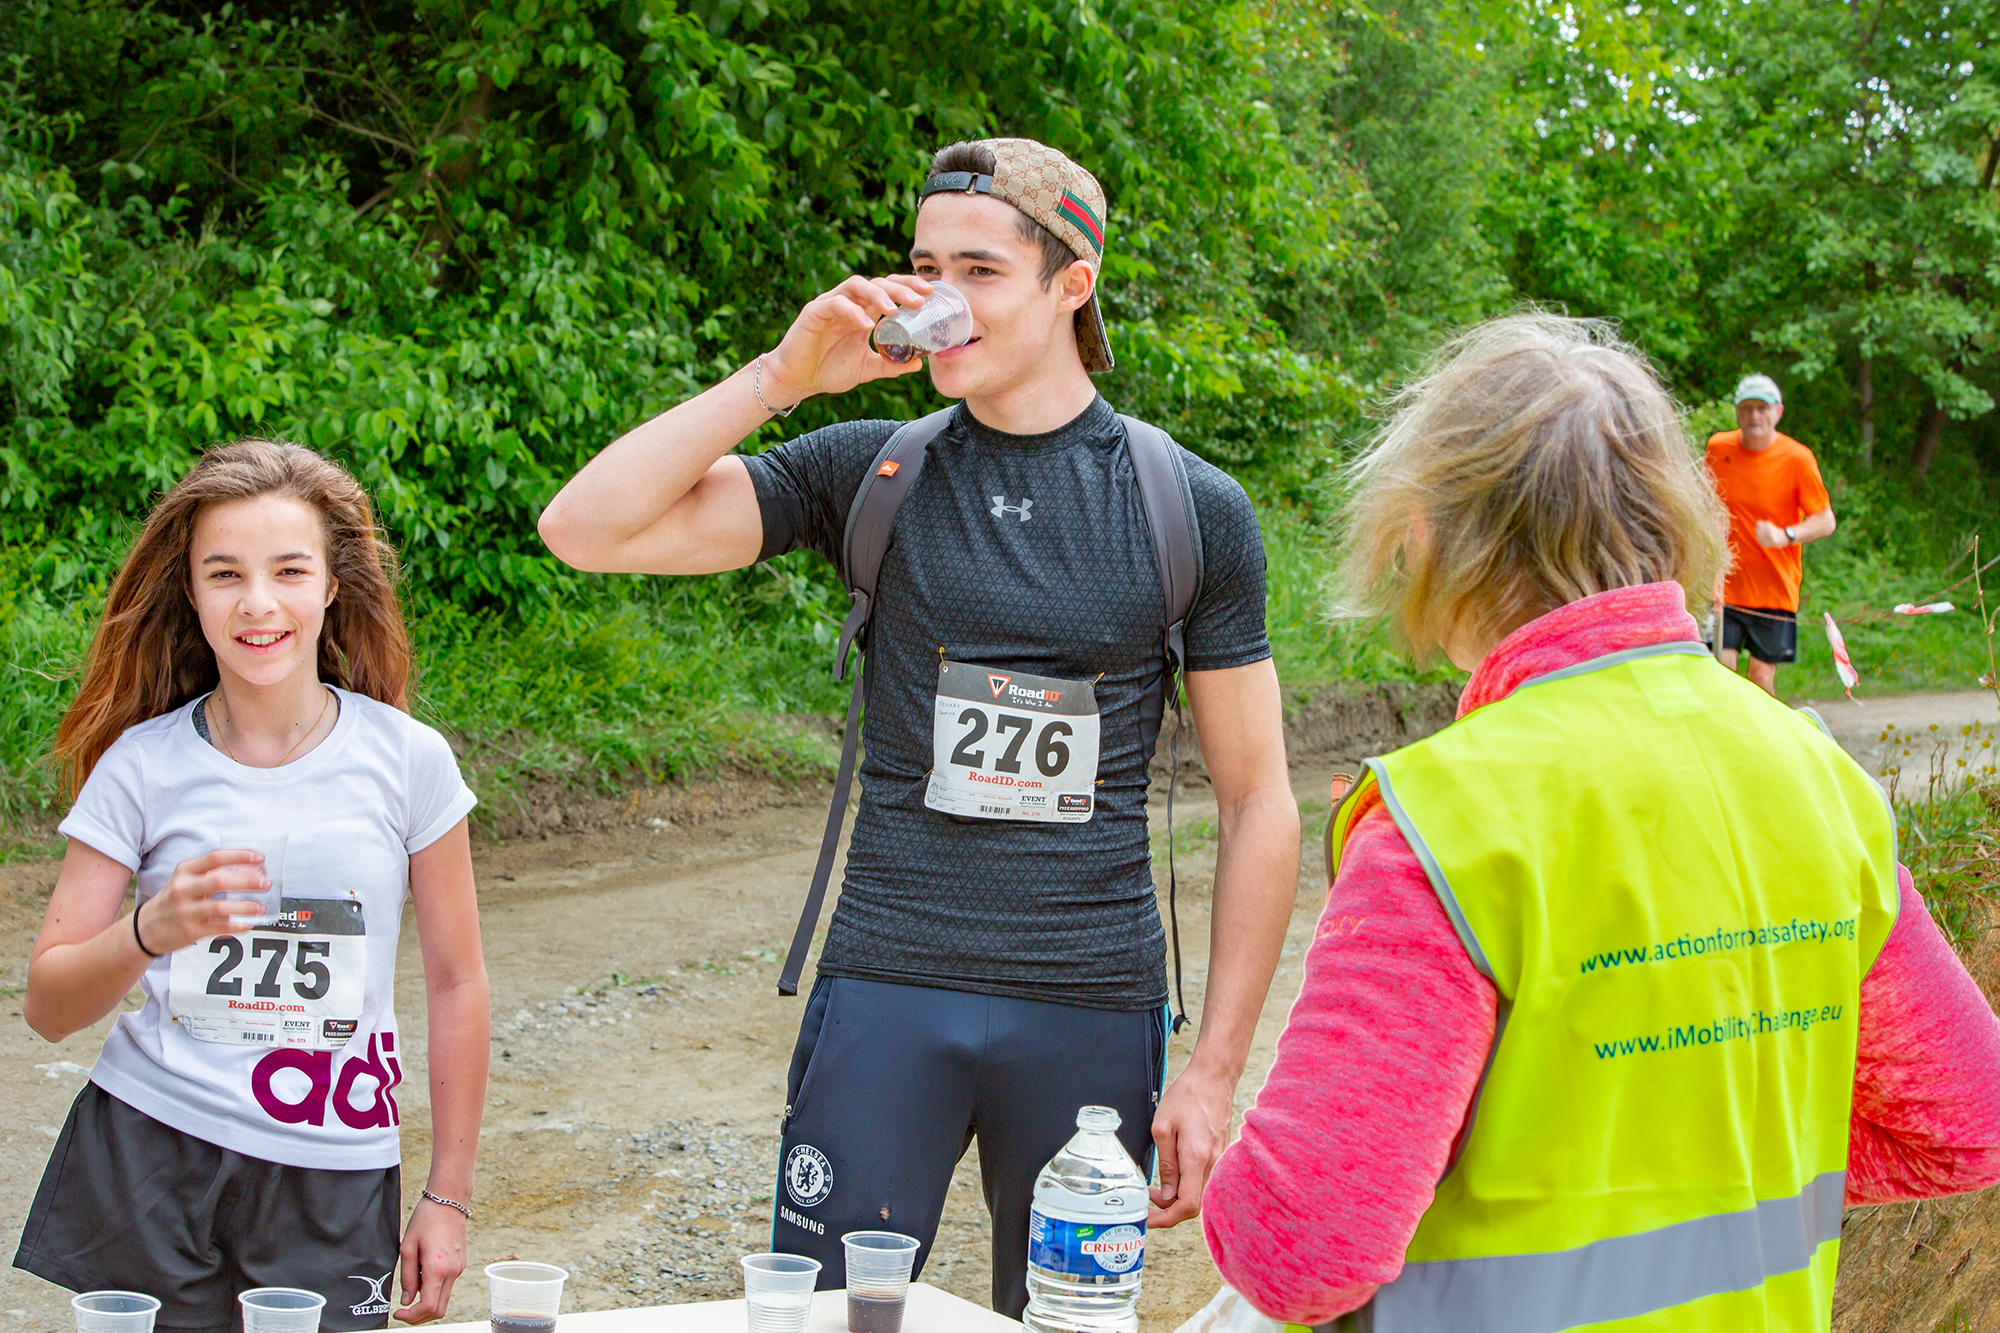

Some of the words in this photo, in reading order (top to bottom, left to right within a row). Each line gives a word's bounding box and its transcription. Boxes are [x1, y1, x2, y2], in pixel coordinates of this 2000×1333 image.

[1008, 684, 1060, 702] RoadID
[950, 707, 1074, 778] 276
[968, 771, 1043, 789] RoadID.com
[1021, 795, 1047, 803] EVENT
[205, 934, 331, 1001] 275
[228, 1000, 306, 1012] RoadID.com
[795, 1147, 826, 1168] CHELSEA
[780, 1205, 825, 1236] SAMSUNG
